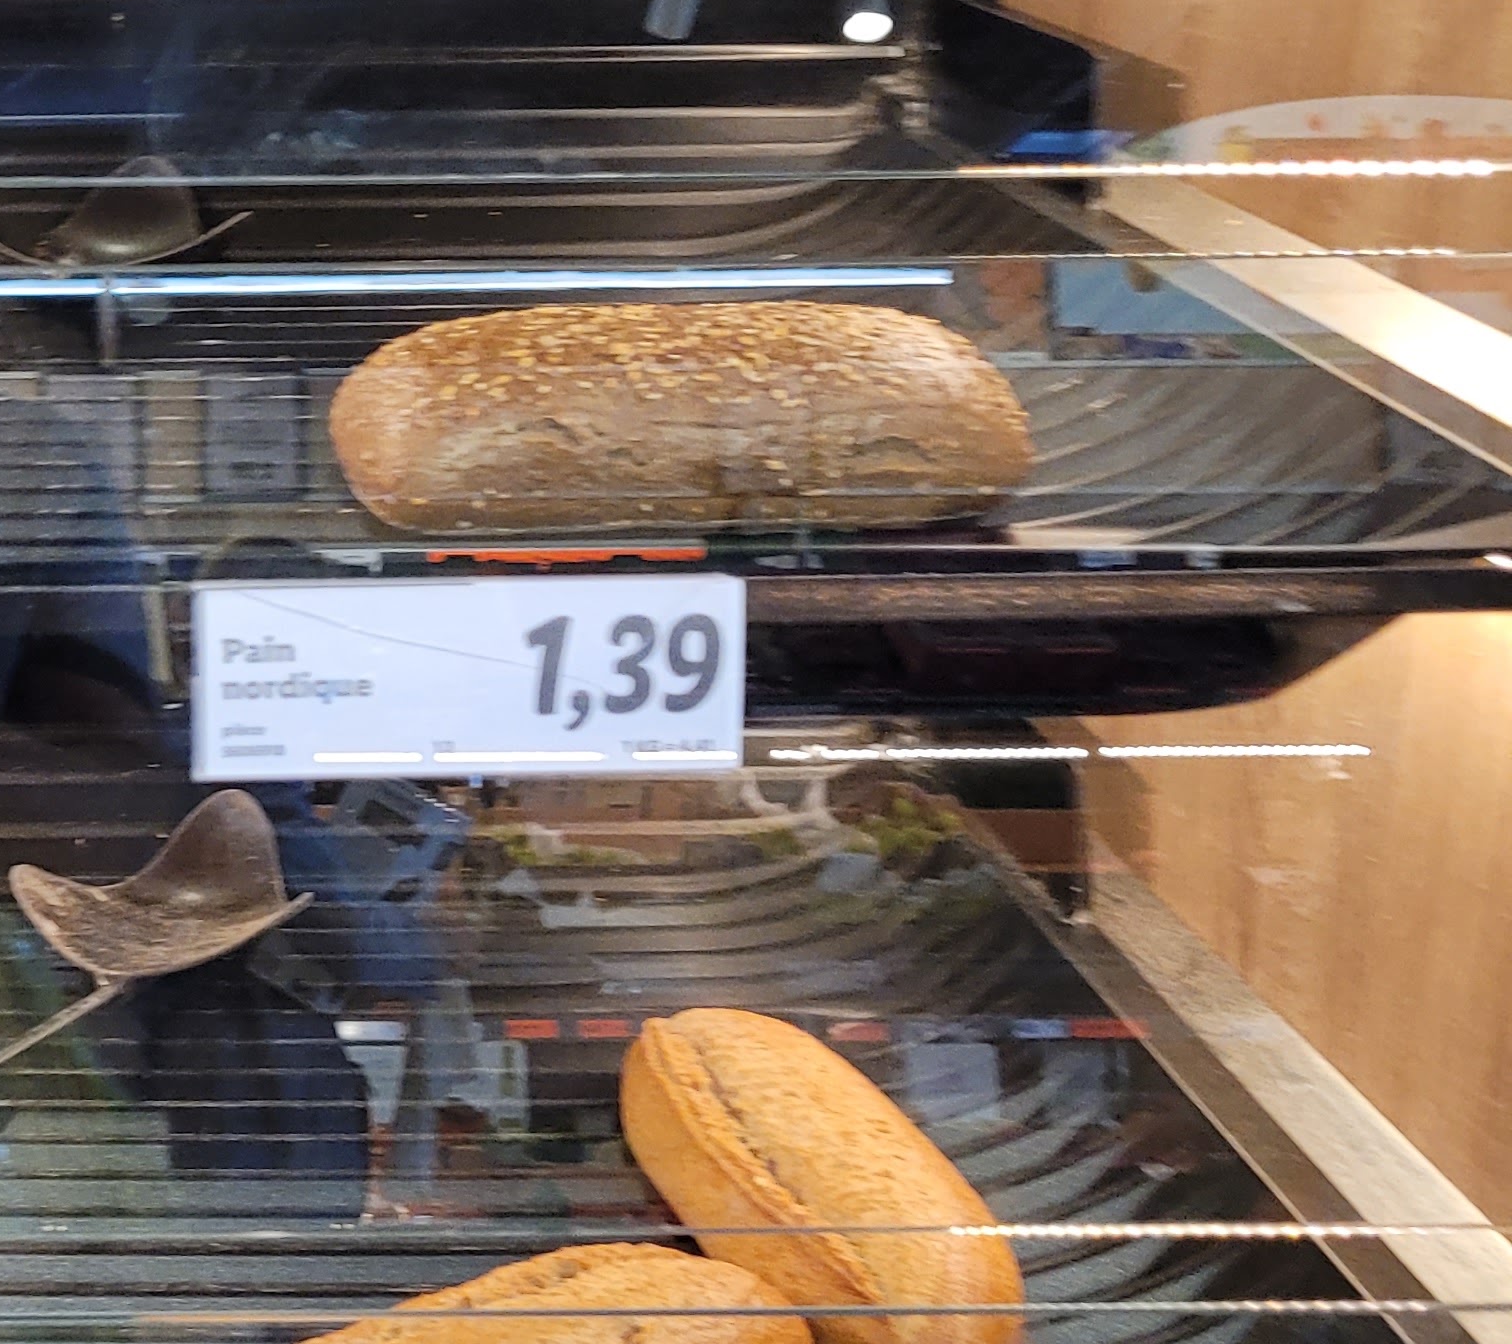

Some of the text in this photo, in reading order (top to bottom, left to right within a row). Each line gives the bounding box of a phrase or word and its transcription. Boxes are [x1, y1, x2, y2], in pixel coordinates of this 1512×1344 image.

[221, 635, 295, 663] Pain
[221, 671, 373, 704] nordique
[526, 613, 720, 731] 1,39
